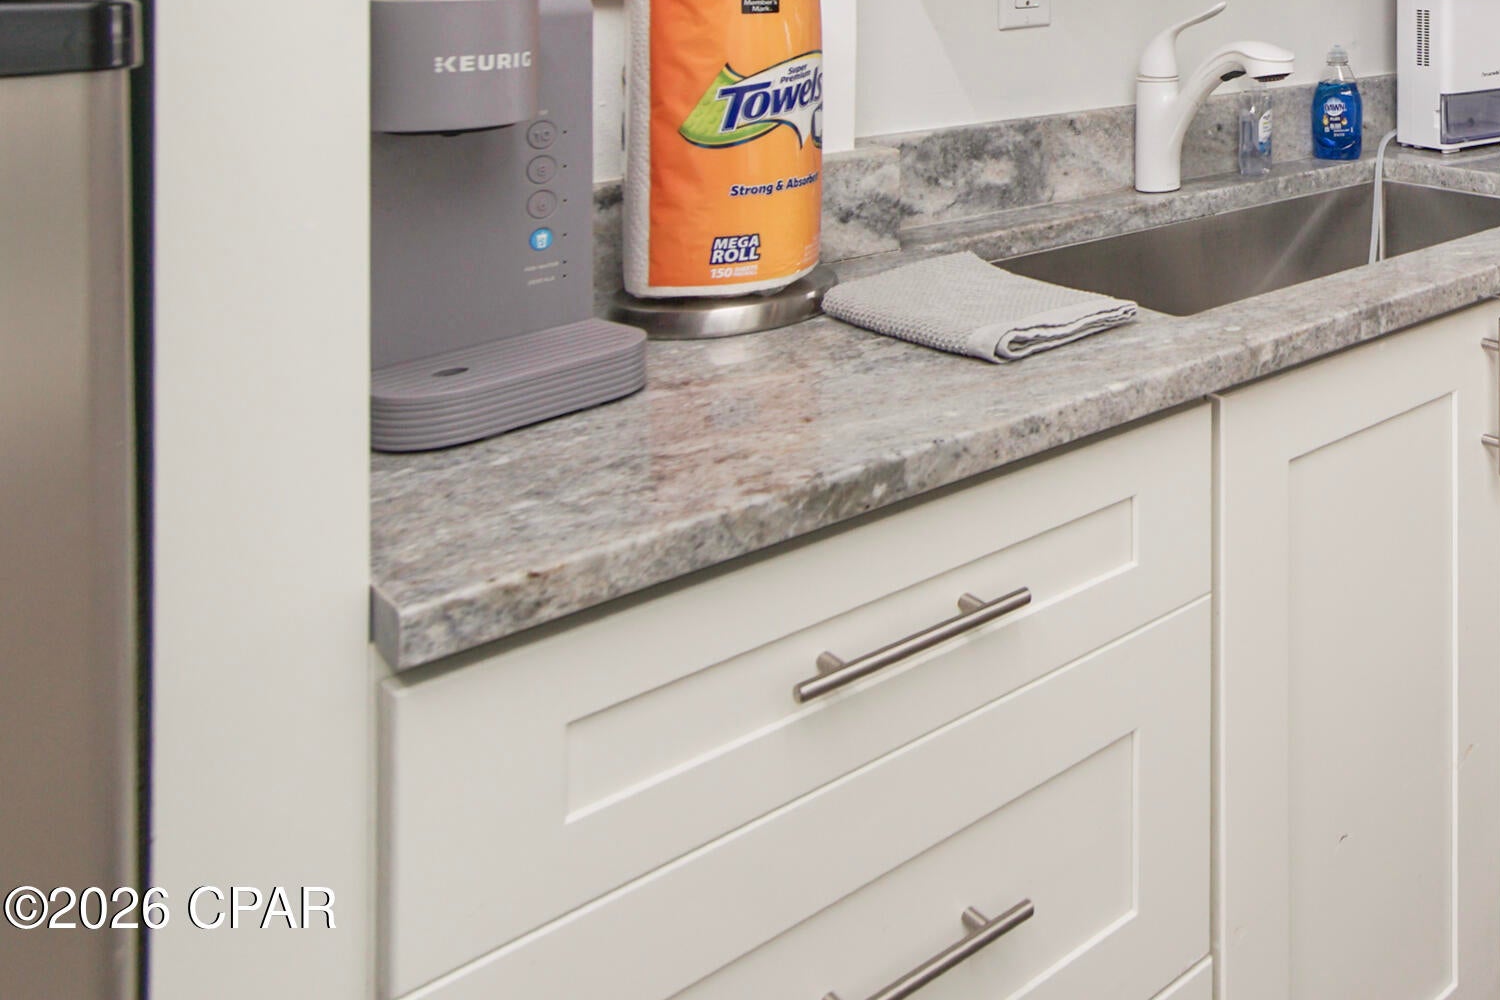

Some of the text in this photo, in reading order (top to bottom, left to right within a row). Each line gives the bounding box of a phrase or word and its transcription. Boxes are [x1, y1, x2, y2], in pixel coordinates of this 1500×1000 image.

[434, 51, 532, 73] KEURIG
[788, 64, 807, 75] Super
[780, 70, 811, 84] Premium
[718, 66, 822, 132] Towels
[730, 184, 773, 197] Strong
[776, 180, 784, 191] &
[713, 234, 760, 250] MEGA
[711, 248, 760, 264] ROLL
[710, 267, 733, 279] 150
